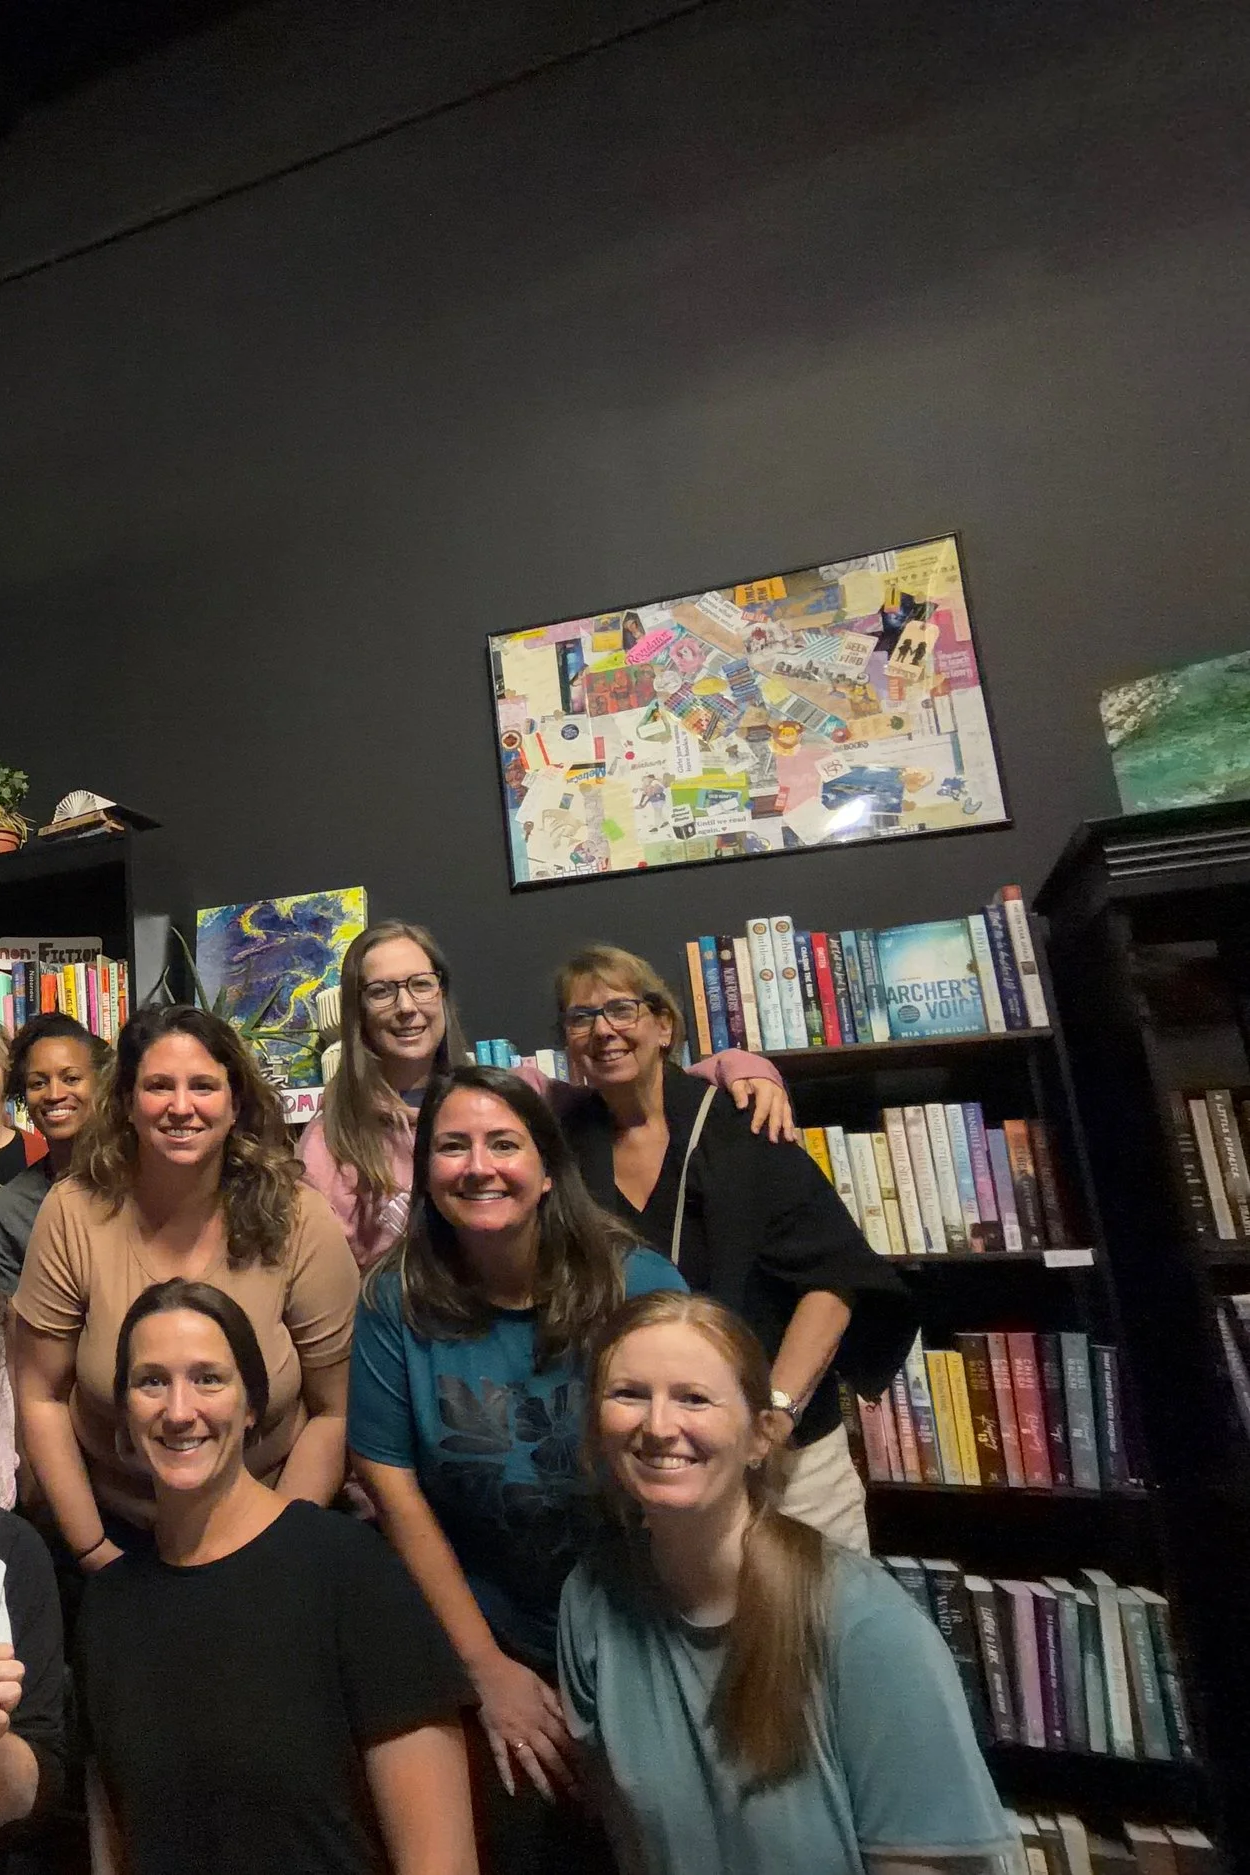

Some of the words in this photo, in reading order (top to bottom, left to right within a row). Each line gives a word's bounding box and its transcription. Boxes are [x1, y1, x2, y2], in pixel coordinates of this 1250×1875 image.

[626, 630, 671, 664] Regulator
[844, 641, 870, 653] SEEK
[696, 818, 718, 828] Until
[728, 816, 747, 825] read
[800, 946, 811, 971] CHASING
[705, 967, 719, 986] NORA
[724, 967, 737, 985] NORA
[886, 975, 983, 1004] ARCHER'S
[708, 985, 722, 1013] ROBERTS
[726, 984, 742, 1012] ROBERTS
[103, 1010, 112, 1041] VAPING
[901, 1031, 921, 1039] MIA
[924, 1024, 980, 1037] SHERIDAN
[1215, 1103, 1230, 1134] LITTLE
[895, 1129, 907, 1163] DANIELLE
[930, 1106, 943, 1143] DANIELLE
[938, 1146, 950, 1171] STEEL
[950, 1107, 963, 1149] DANIELLE
[957, 1148, 968, 1172] STEEL
[965, 1107, 981, 1147] DANIELLE
[973, 1146, 986, 1172] STEEL
[898, 1164, 910, 1186] STEEL
[913, 1134, 928, 1175] DANIELLE
[922, 1177, 932, 1204] STEEL
[1106, 1400, 1114, 1420] AFTER
[977, 1433, 988, 1443] 13
[1142, 1670, 1155, 1704] LETTER
